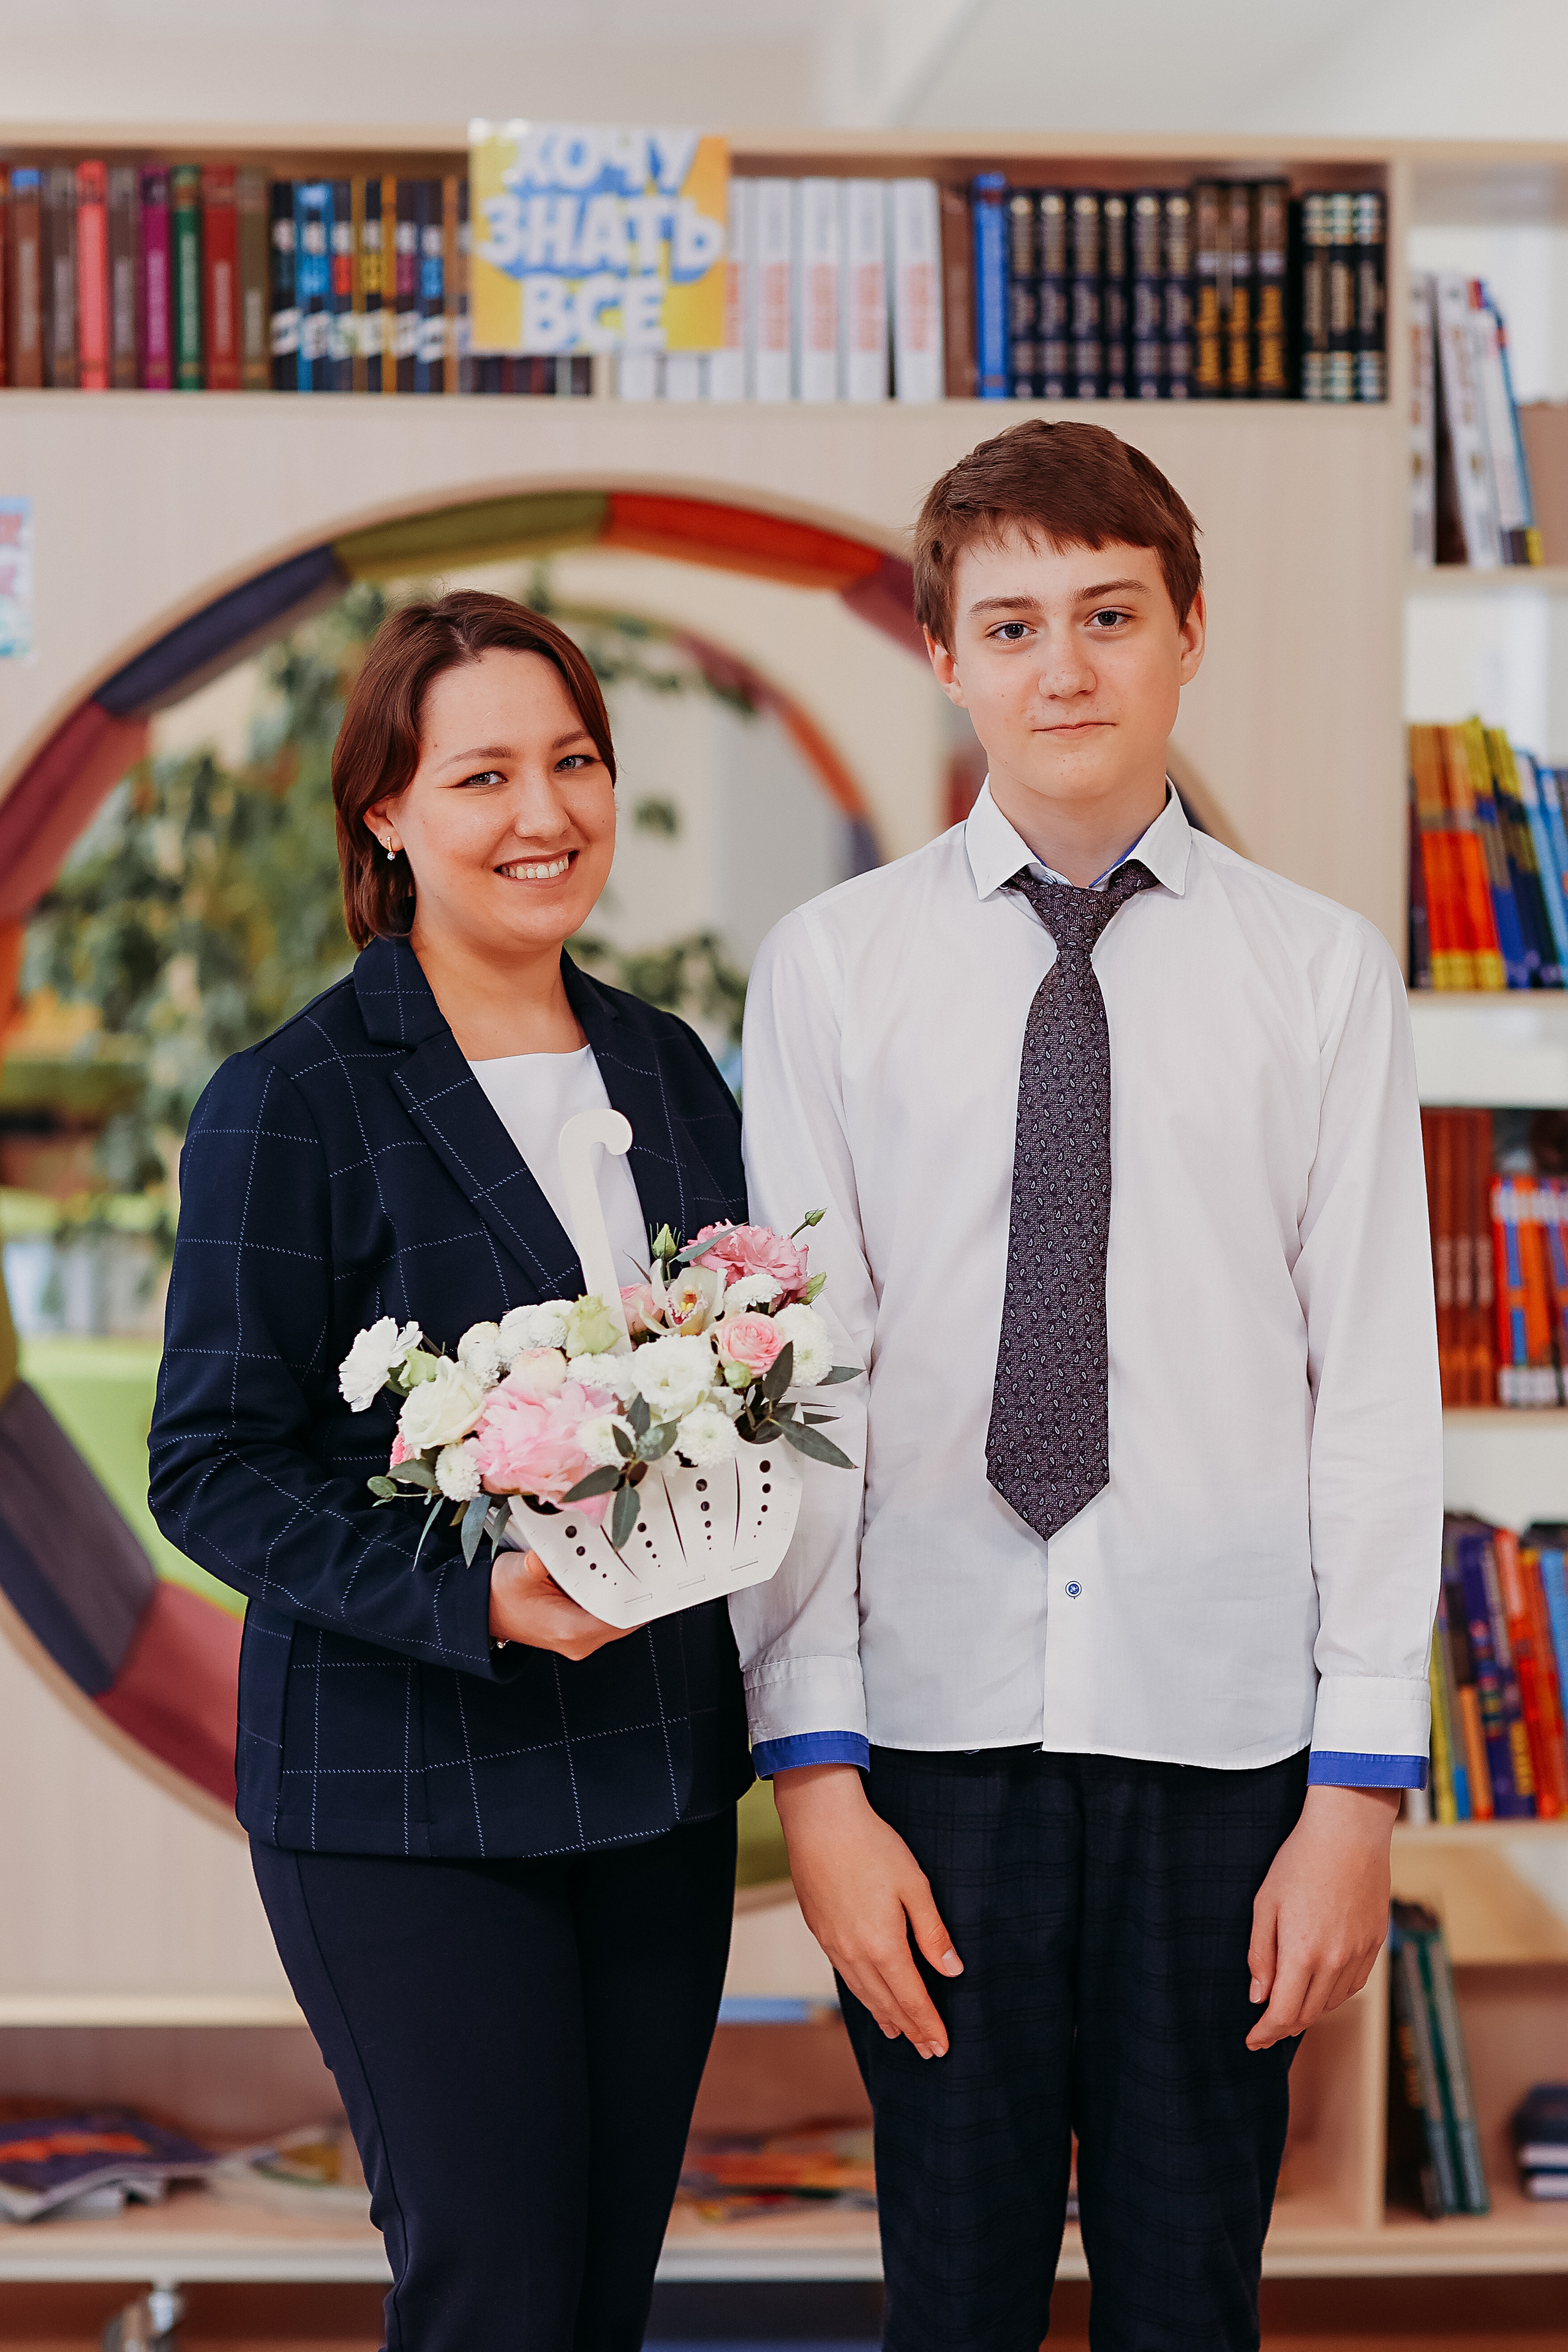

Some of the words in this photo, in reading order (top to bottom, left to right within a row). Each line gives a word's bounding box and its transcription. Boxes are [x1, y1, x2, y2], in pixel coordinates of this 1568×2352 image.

[500, 129, 699, 187] ХОЧУ
[477, 194, 722, 268] ЗНАТЬ
[521, 273, 668, 352] ВСЕ
